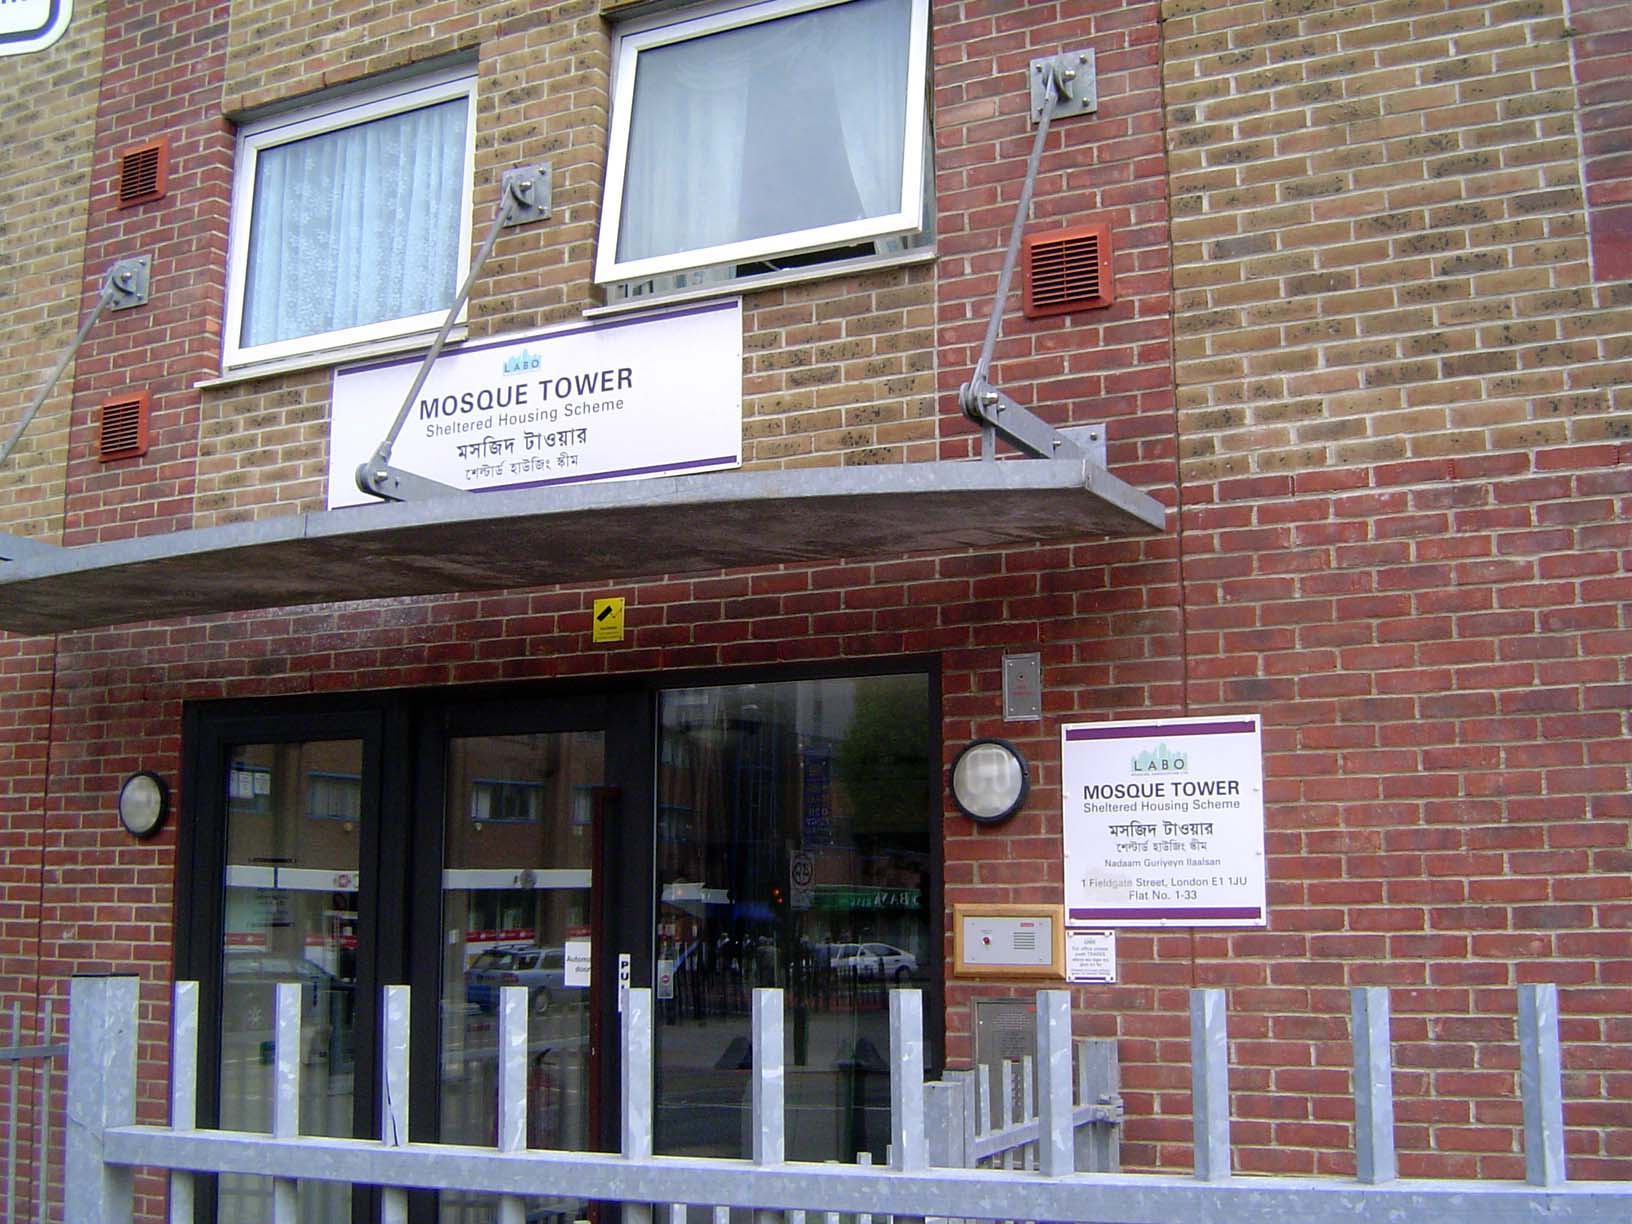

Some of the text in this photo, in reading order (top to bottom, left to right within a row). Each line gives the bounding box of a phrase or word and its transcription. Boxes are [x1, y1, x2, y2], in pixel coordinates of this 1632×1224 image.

[504, 359, 540, 373] LABO
[419, 367, 633, 420] MOSQUE TOWER
[426, 399, 624, 438] Sheltered Housing Scheme
[457, 428, 587, 459] মসজিদ টাওয়ার
[1134, 758, 1185, 771] LABO
[1084, 780, 1240, 800] MOSQUE TOWER
[1083, 799, 1240, 813] Sheltered Housing Scheme
[1108, 820, 1214, 837] মসজিদ টাওয়ার
[1105, 859, 1141, 868] Nadaam
[1144, 858, 1184, 869] Guriyeyn
[1082, 876, 1247, 889] 1 Fieldgate Street, London E1 1JU
[1129, 890, 1197, 901] Flat No. 1-33
